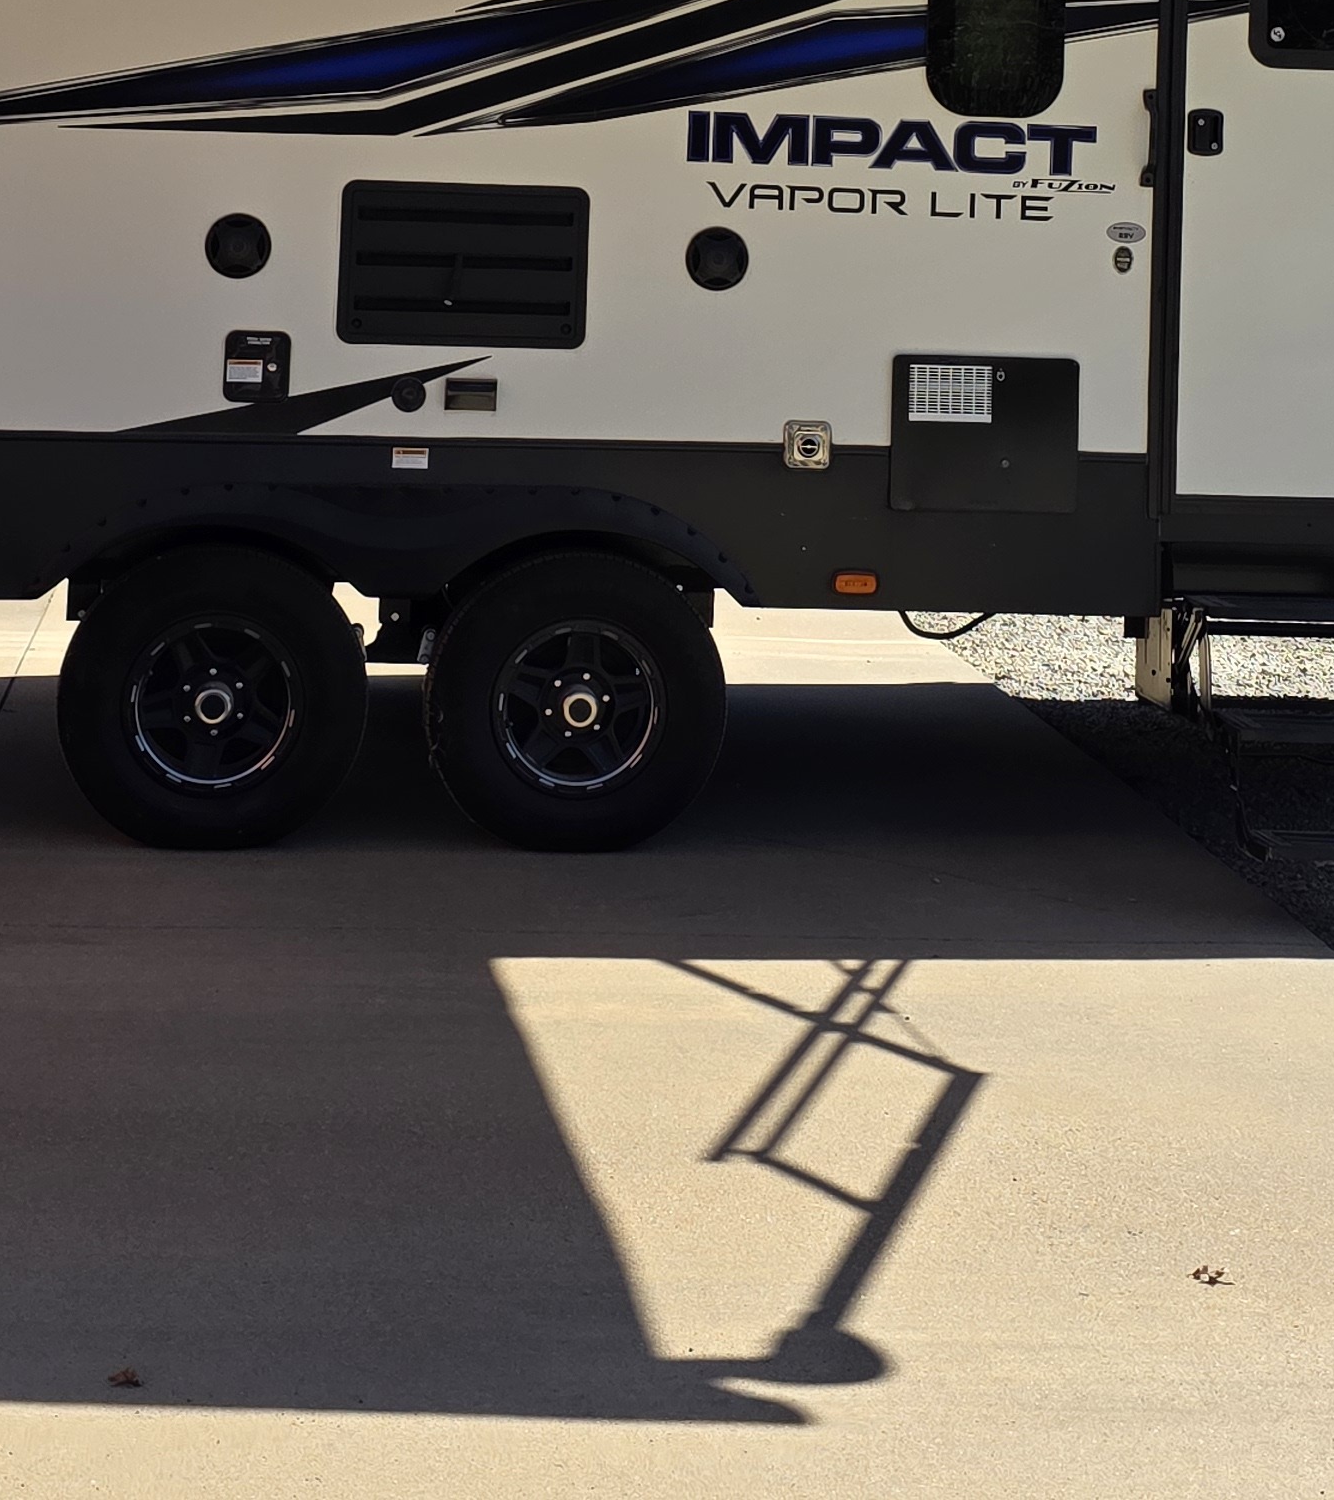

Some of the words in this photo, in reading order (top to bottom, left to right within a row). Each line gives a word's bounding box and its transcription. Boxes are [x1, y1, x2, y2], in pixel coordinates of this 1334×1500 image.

[686, 110, 1097, 176] IMPACT
[706, 181, 908, 216] VAPOR
[930, 191, 1055, 222] LITE
